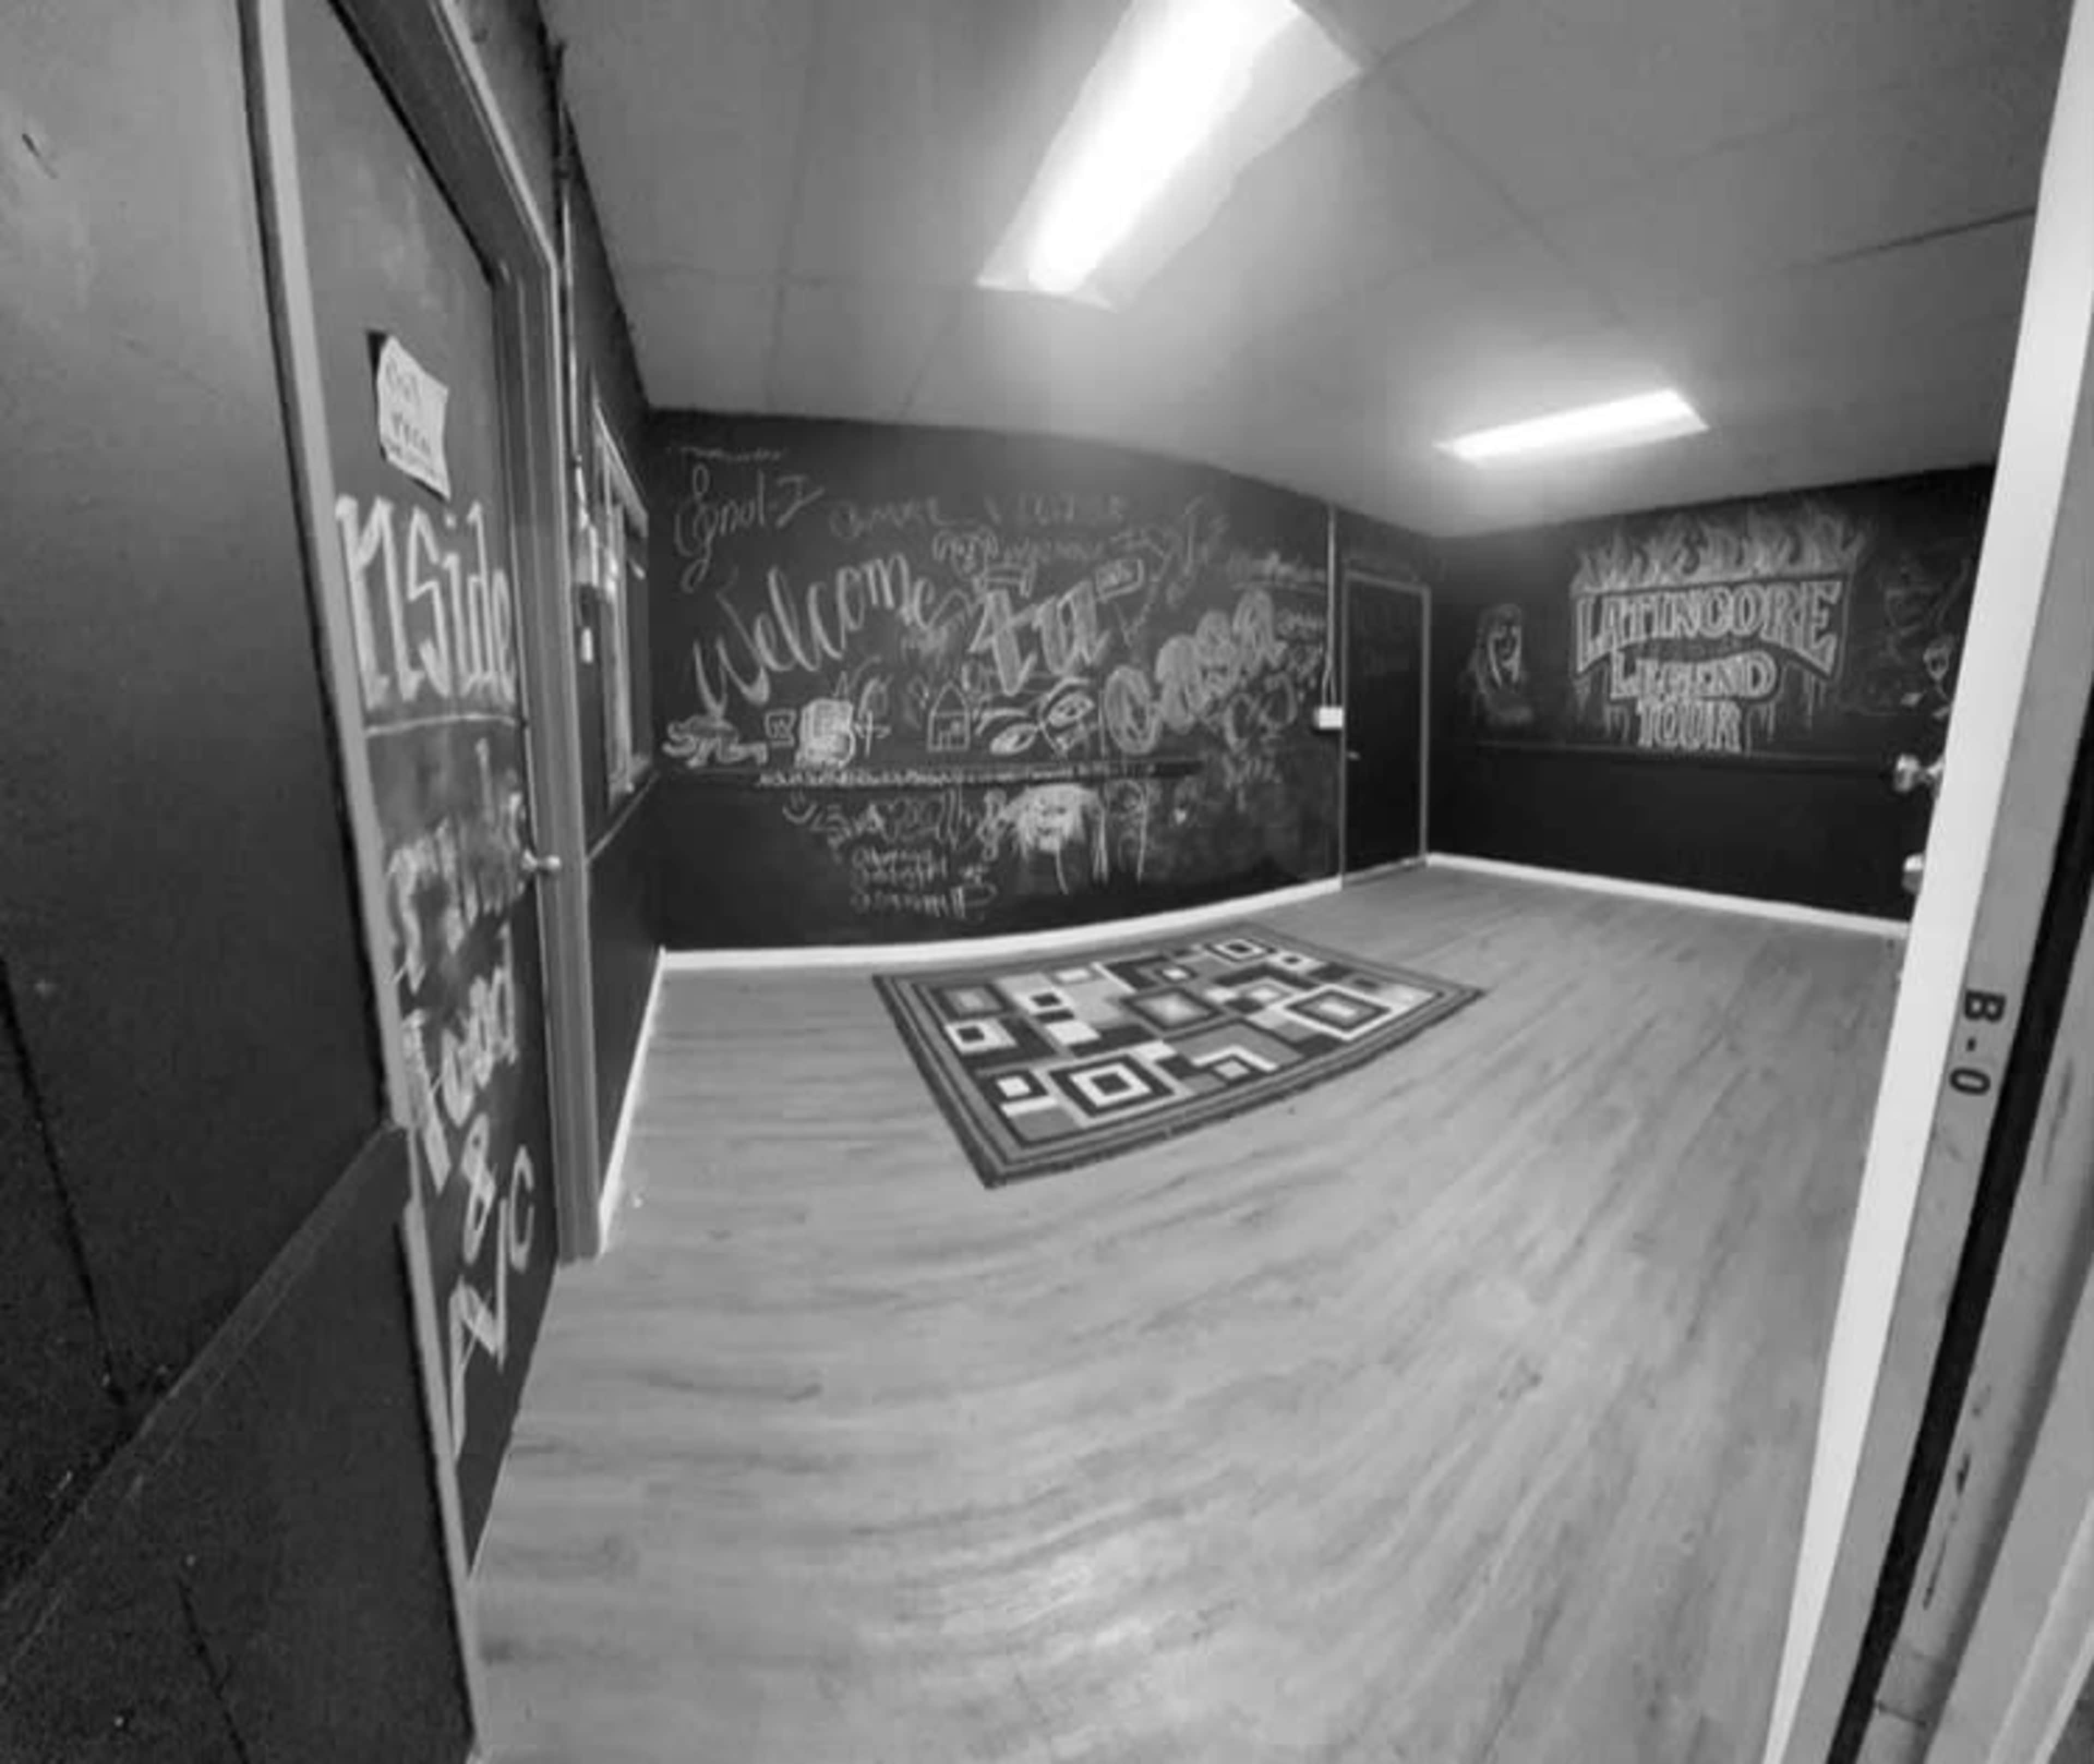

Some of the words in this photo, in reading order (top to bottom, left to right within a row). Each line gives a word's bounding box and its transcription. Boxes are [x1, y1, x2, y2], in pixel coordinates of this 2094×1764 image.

[691, 552, 935, 720] Welcome
[1576, 579, 1843, 675] LATINCORE
[1636, 697, 1743, 754] TOUR
